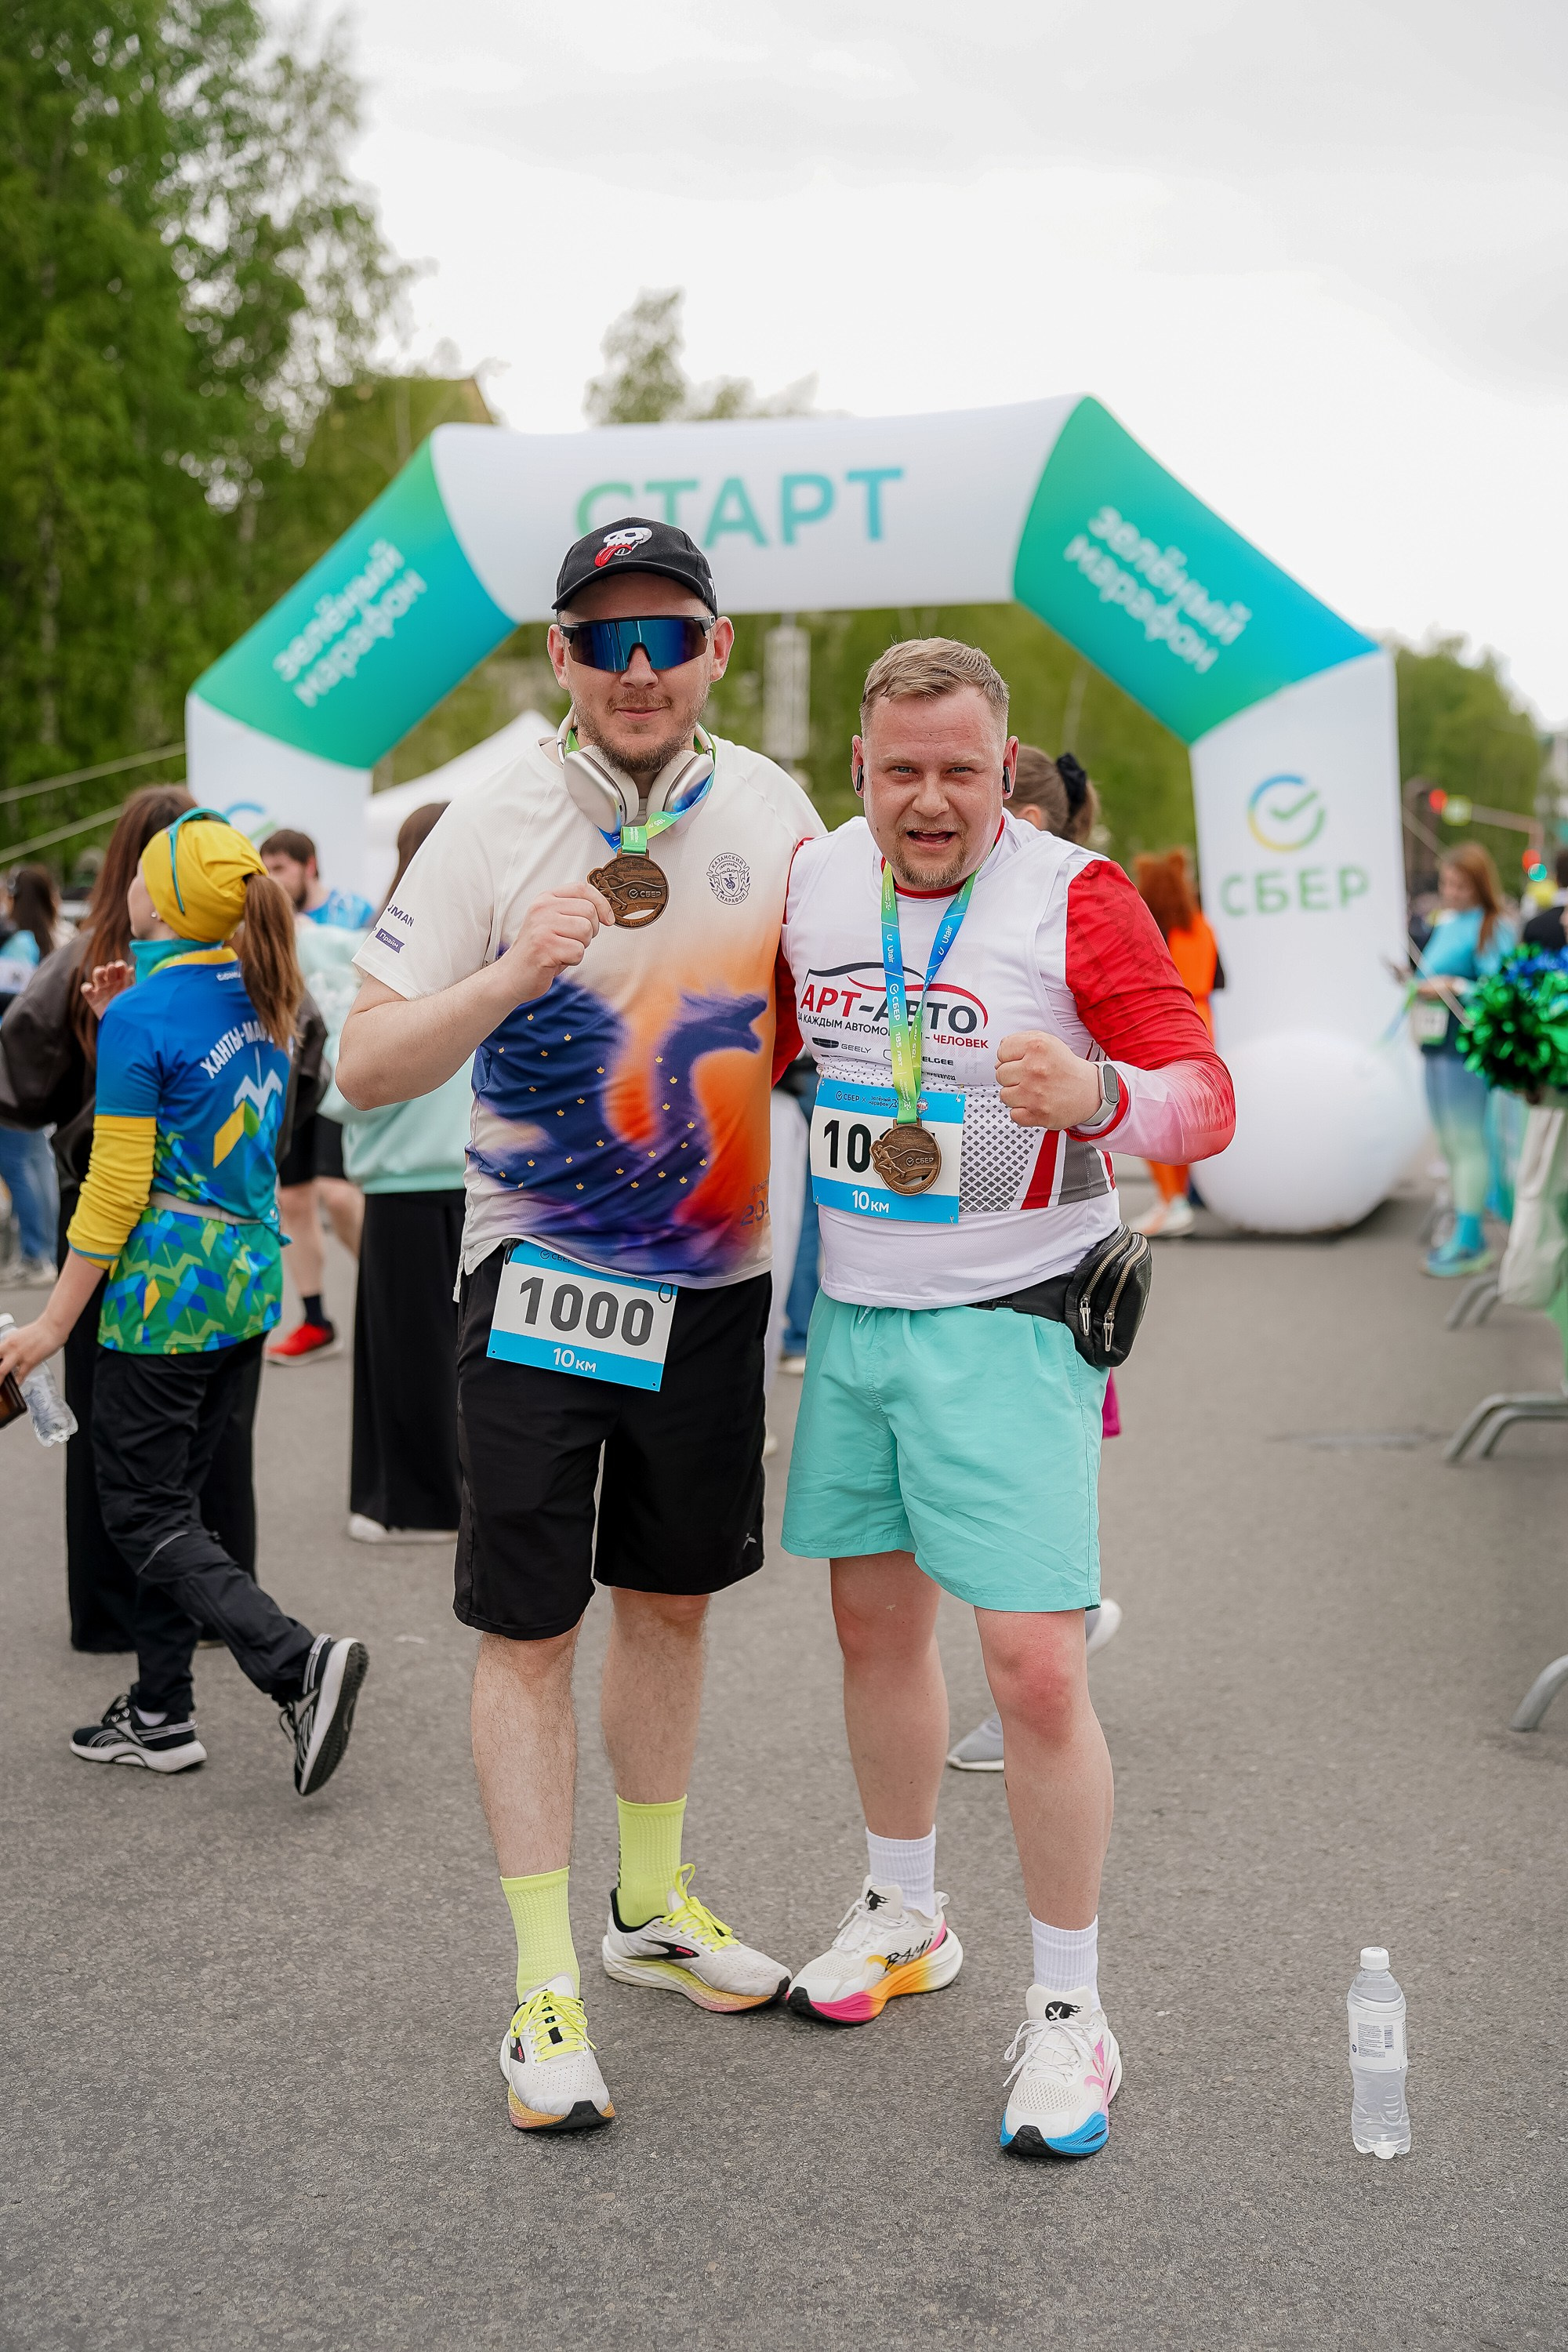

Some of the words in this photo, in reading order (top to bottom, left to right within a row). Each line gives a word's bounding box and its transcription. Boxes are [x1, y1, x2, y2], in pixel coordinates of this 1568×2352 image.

[575, 466, 904, 547] СТАРТ
[720, 892, 746, 903] МАРАФОН
[1219, 866, 1369, 916] СБЕР
[379, 931, 399, 949] Прайм
[942, 925, 953, 944] Utair
[891, 996, 901, 1022] СБЕР
[803, 1014, 843, 1029] КАЖДЫМ
[933, 1033, 989, 1049] ЧЕЛОВЕК
[840, 1044, 872, 1054] GEELY
[921, 1056, 954, 1066] ELGEE
[843, 1094, 859, 1102] СБЕР
[739, 1200, 769, 1227] 20
[519, 1276, 655, 1346] 1000
